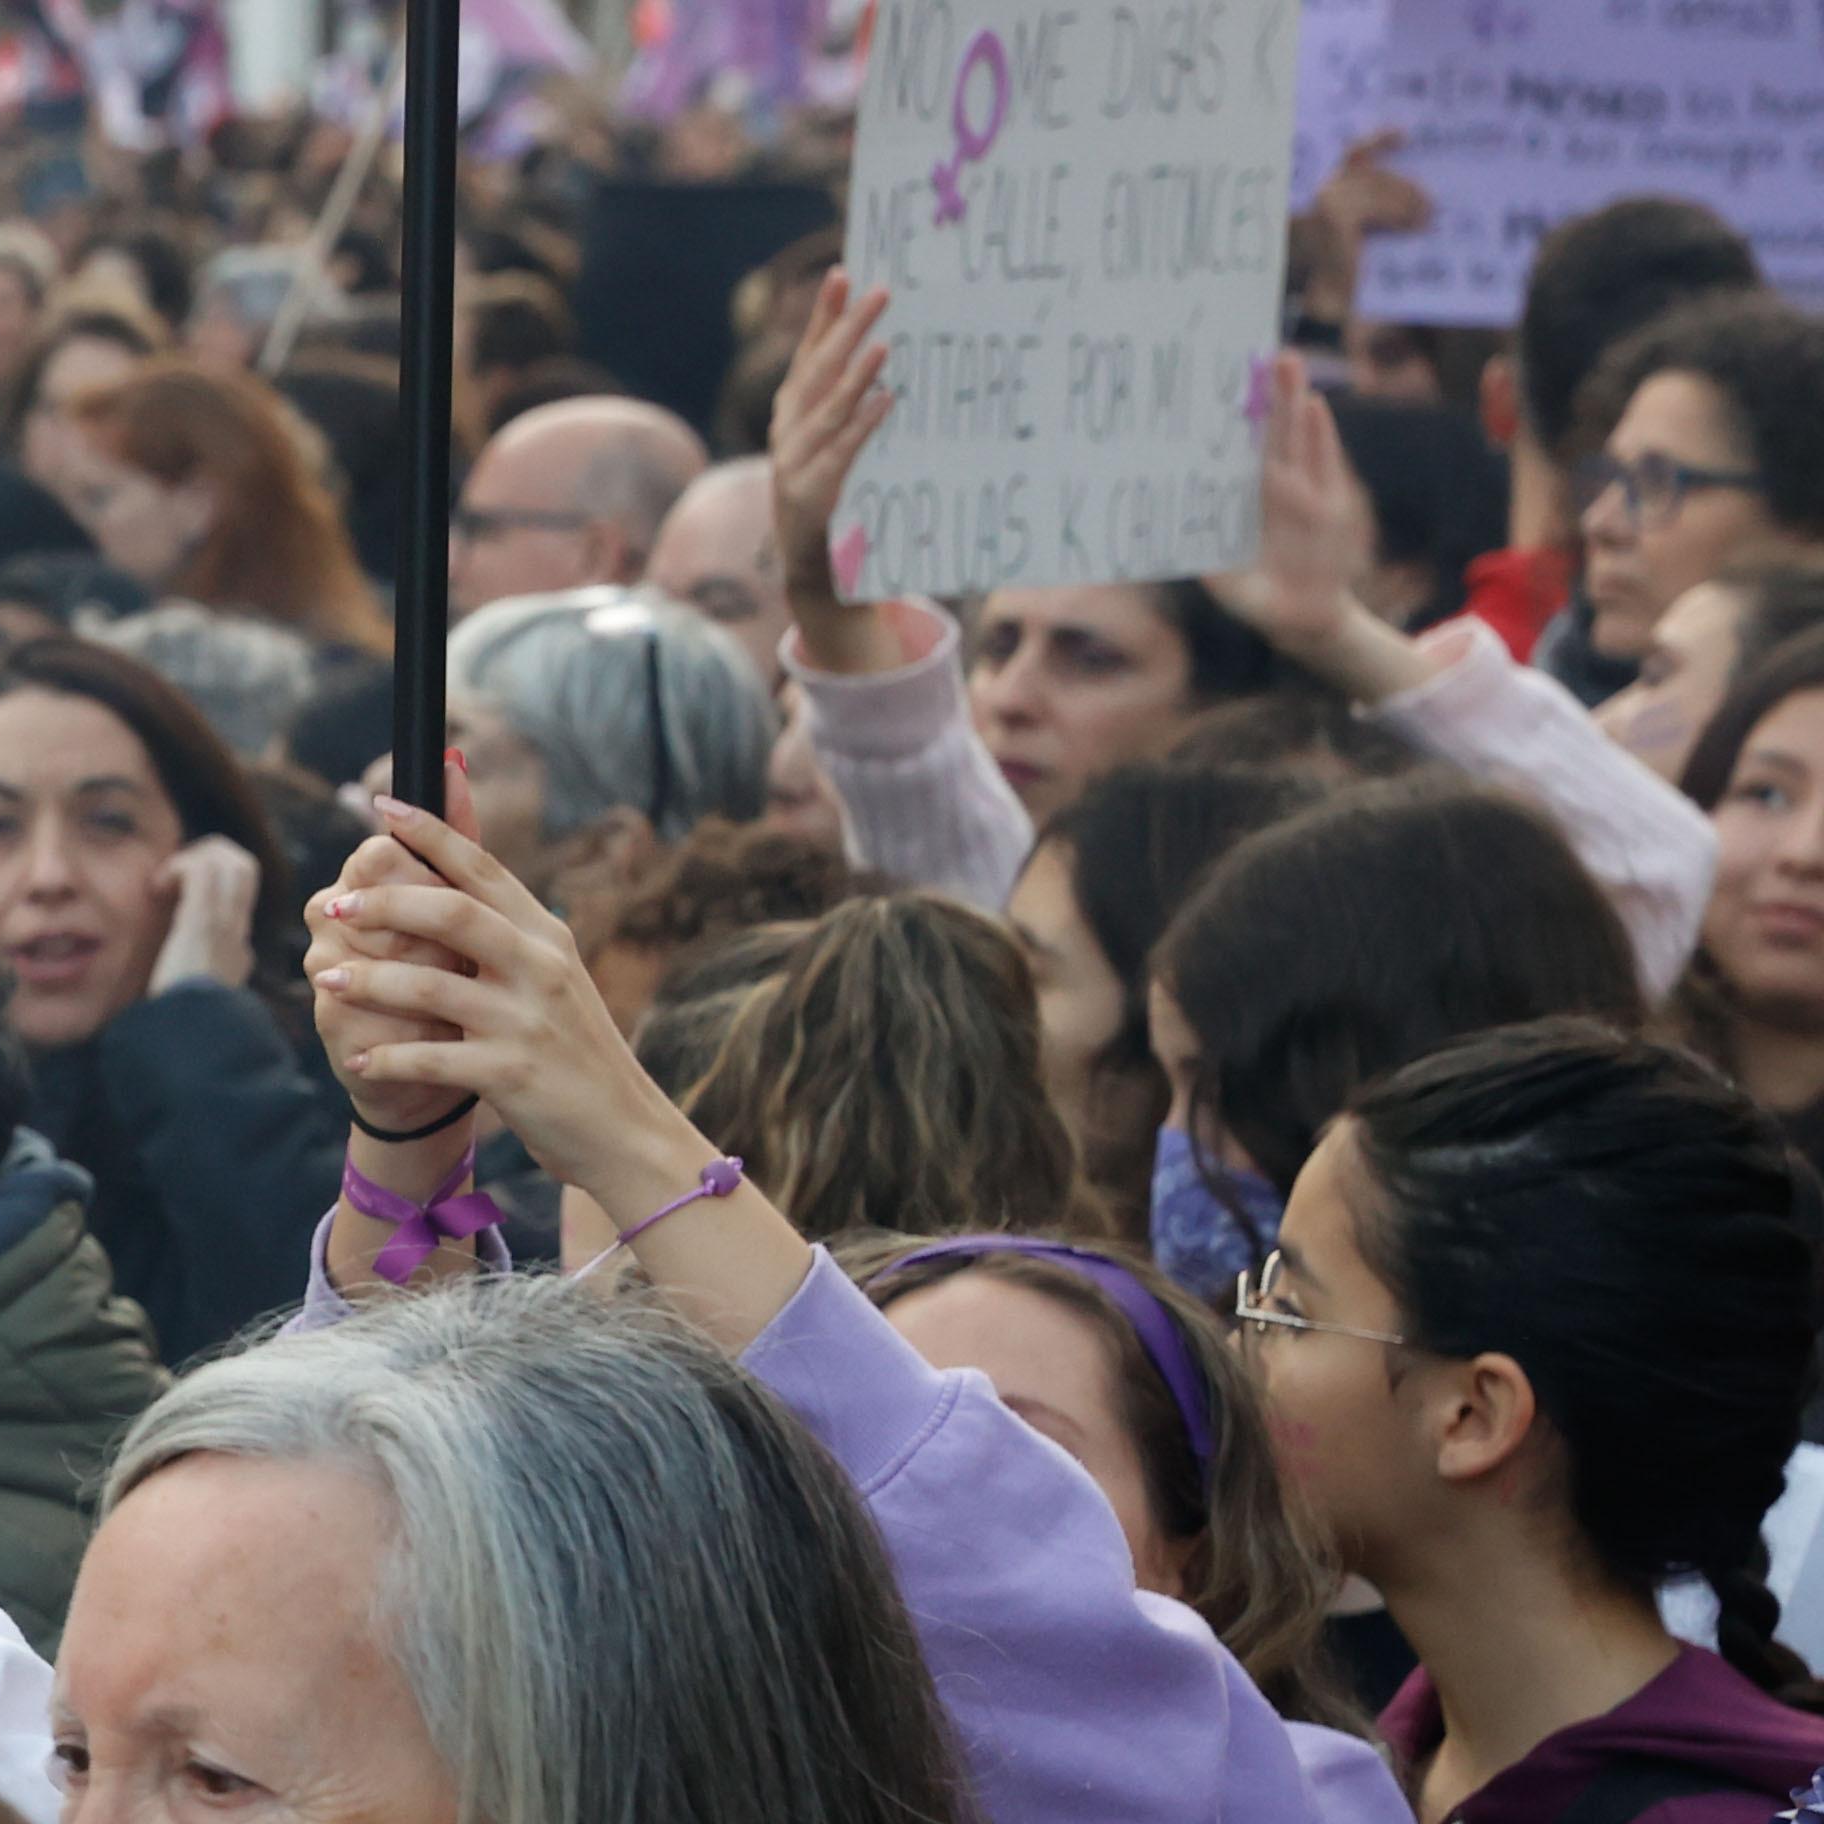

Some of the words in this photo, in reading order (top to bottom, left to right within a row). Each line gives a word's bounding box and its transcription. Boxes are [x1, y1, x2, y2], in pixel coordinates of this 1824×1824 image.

[882, 2, 954, 121] NO
[1007, 10, 1079, 128] ME
[863, 178, 922, 291] ME
[1065, 330, 1138, 445] POR
[1057, 474, 1091, 577] K
